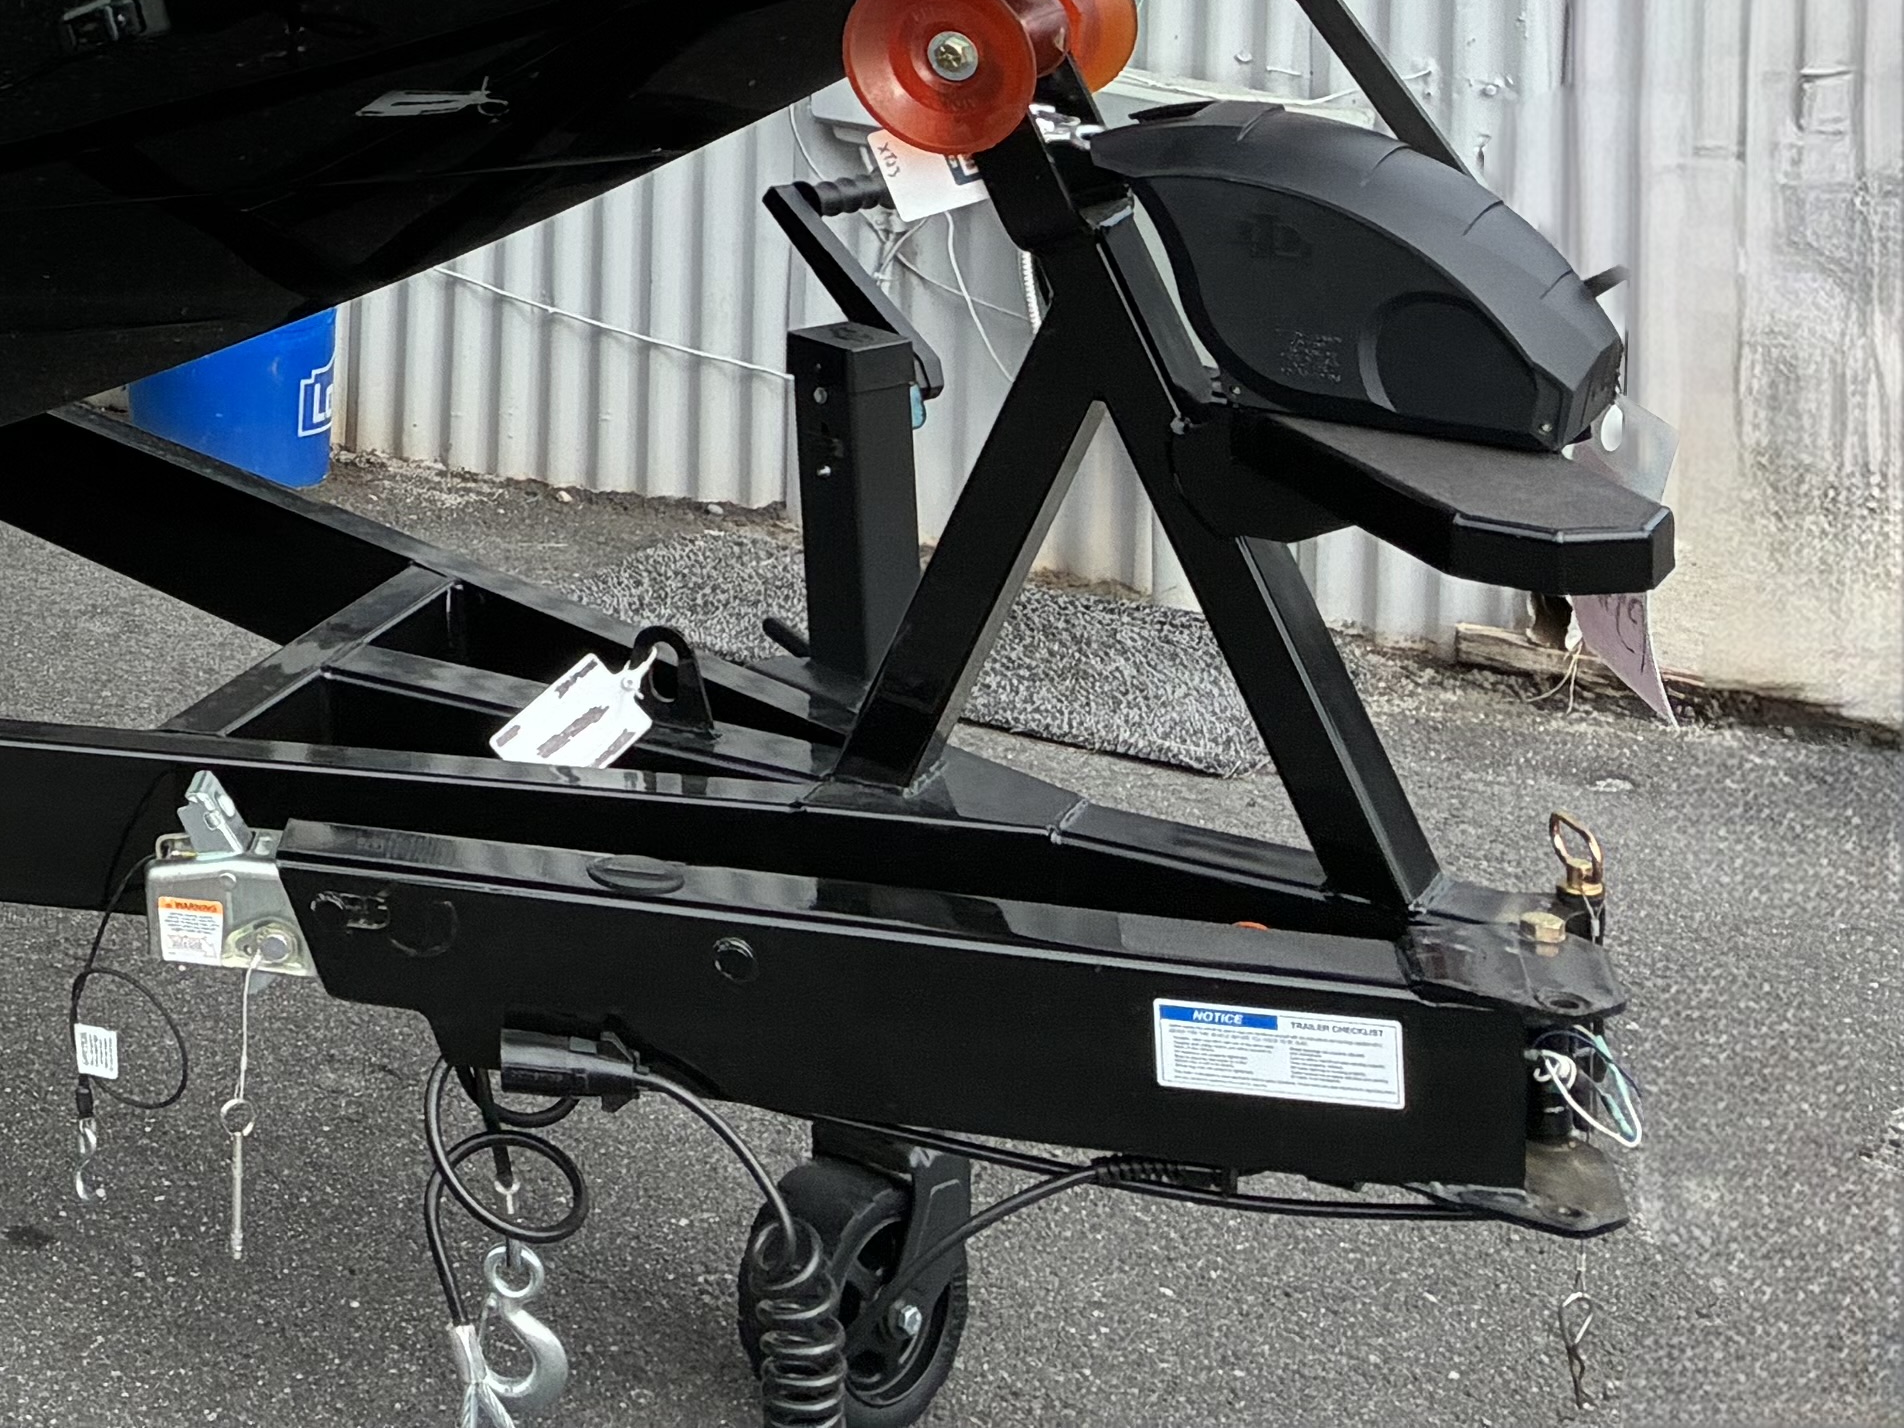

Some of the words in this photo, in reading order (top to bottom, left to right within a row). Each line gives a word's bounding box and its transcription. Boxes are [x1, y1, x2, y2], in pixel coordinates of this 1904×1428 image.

[1192, 1009, 1243, 1026] NOTICE
[1290, 1020, 1331, 1033] TRAILER
[1331, 1023, 1384, 1037] CHECKLIST
